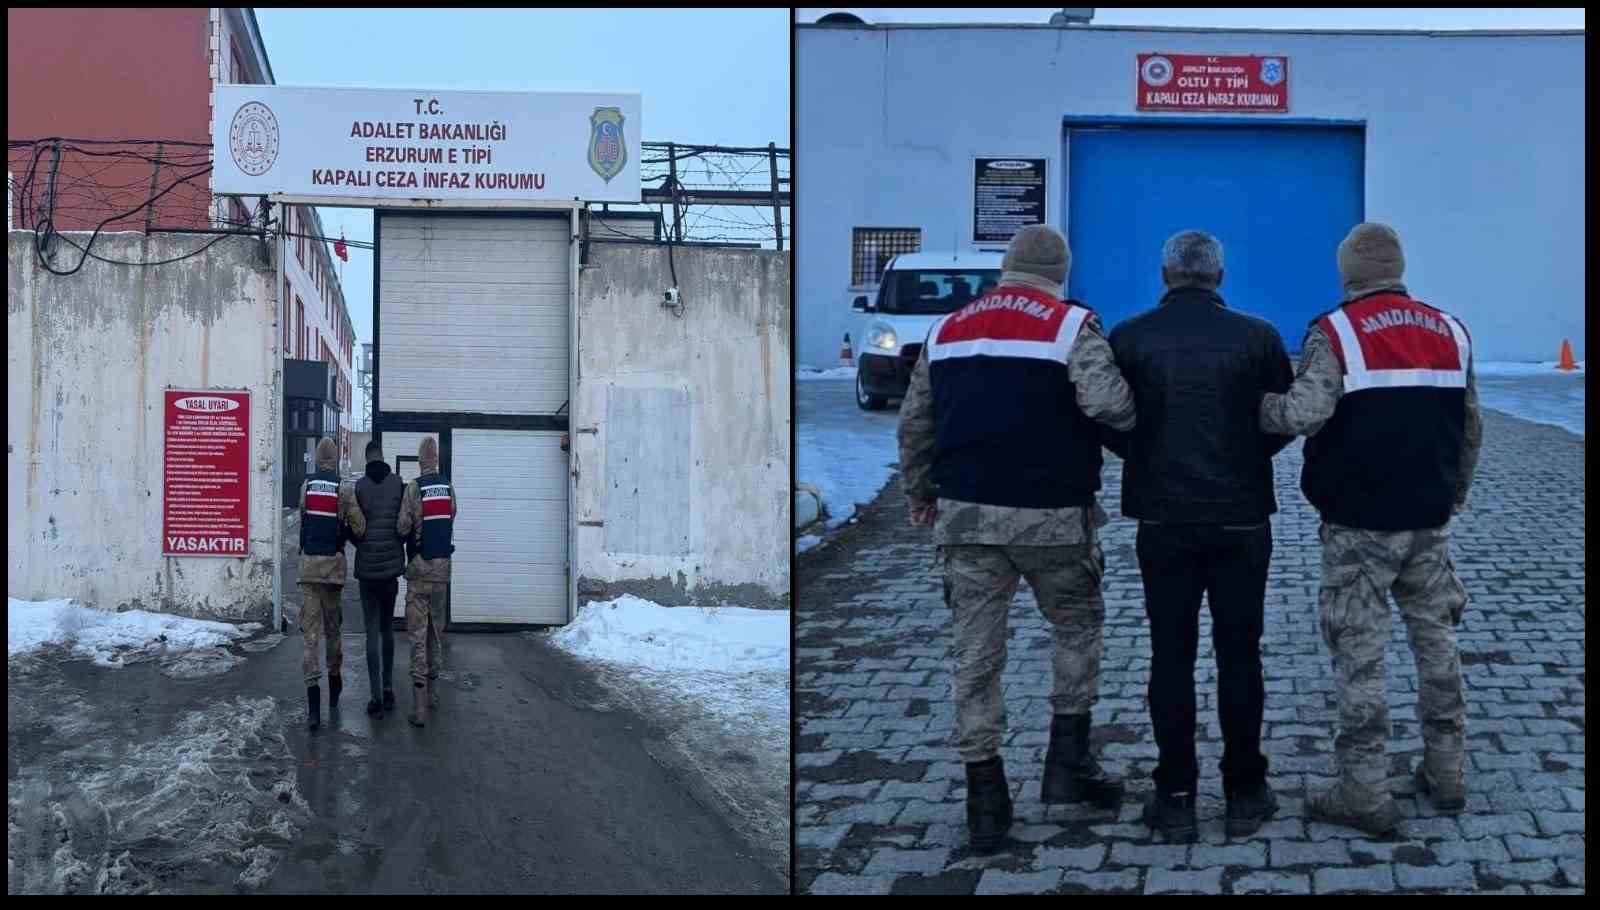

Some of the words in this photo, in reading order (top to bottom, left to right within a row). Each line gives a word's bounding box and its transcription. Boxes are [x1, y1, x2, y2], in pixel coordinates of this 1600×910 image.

[1177, 76, 1209, 88] OLTU
[1214, 77, 1221, 88] T
[1226, 74, 1249, 89] TİPİ
[413, 98, 444, 115] T.C.
[1146, 91, 1180, 105] KAPALI
[1182, 92, 1205, 105] CEZA
[1207, 90, 1234, 106] İNFAZ
[1237, 93, 1279, 106] KURUMU
[350, 121, 415, 139] ADALET
[419, 120, 507, 141] BAKANLIĞI
[366, 146, 443, 164] ERZURUM
[447, 148, 458, 164] E
[462, 145, 492, 165] TİPİ
[312, 168, 371, 187] KAPALI
[375, 171, 418, 188] CEZA
[423, 167, 471, 189] İNFAZ
[475, 172, 546, 190] KURUMU
[955, 293, 1055, 323] JANDARMA
[1360, 308, 1450, 338] JANDARMA
[185, 399, 207, 409] YASAL
[208, 400, 230, 410] UYARI
[167, 536, 246, 552] YASAKTIR
